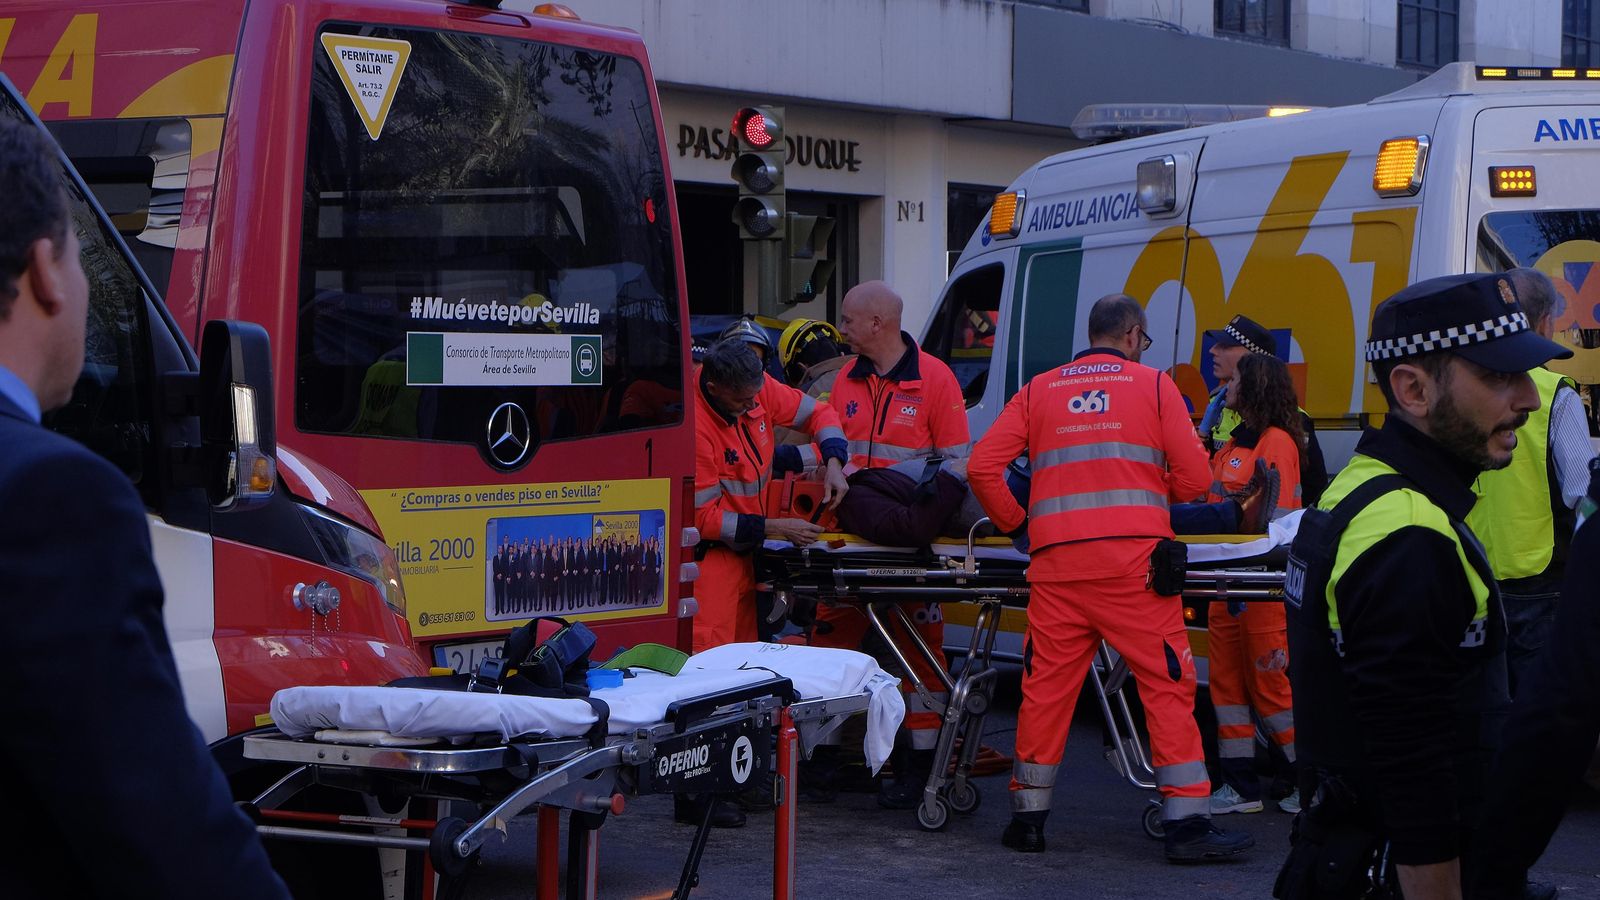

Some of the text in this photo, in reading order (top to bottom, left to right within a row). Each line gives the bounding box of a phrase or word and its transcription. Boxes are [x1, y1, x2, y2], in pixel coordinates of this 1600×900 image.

[341, 50, 394, 64] PERMÍTAME
[355, 63, 382, 75] SALIR
[370, 82, 383, 90] 73.2
[362, 90, 380, 98] R.G.C.
[677, 124, 739, 161] PASA
[1027, 192, 1140, 233] AMBULANCIA
[410, 296, 600, 326] #MuéveteporSevilla
[446, 345, 570, 362] Consorcio de Transporte Metropolitano
[502, 364, 512, 374] de
[512, 364, 537, 374] Sevilla
[1061, 363, 1122, 377] TÉCNICO
[1094, 375, 1134, 383] SANITARIAS
[401, 484, 602, 508] ¿Compras o vendes piso en Sevilla?
[429, 537, 475, 561] 2000
[400, 565, 440, 576] NMOBILIARIA
[668, 744, 709, 775] FERNO
